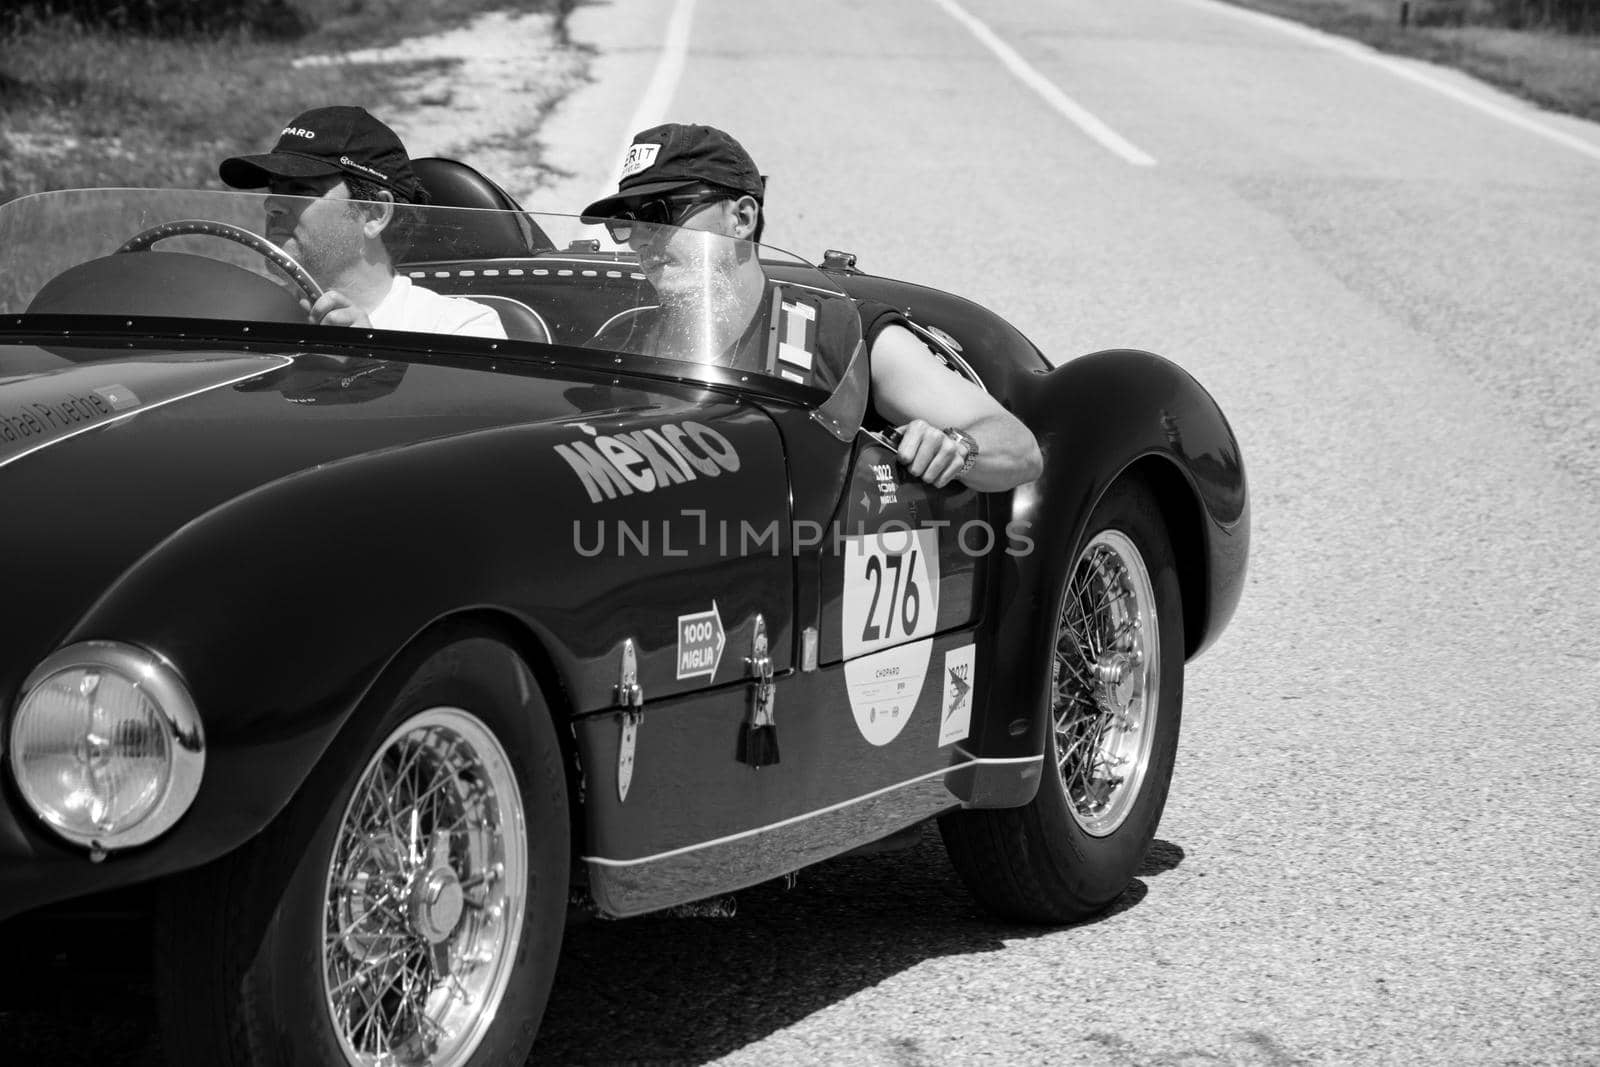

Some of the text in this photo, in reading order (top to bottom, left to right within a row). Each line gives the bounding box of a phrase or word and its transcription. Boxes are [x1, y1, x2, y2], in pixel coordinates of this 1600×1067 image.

[873, 464, 893, 481] 2022
[862, 550, 920, 642] 276
[684, 621, 713, 644] 1000
[681, 646, 714, 671] MIGLIA
